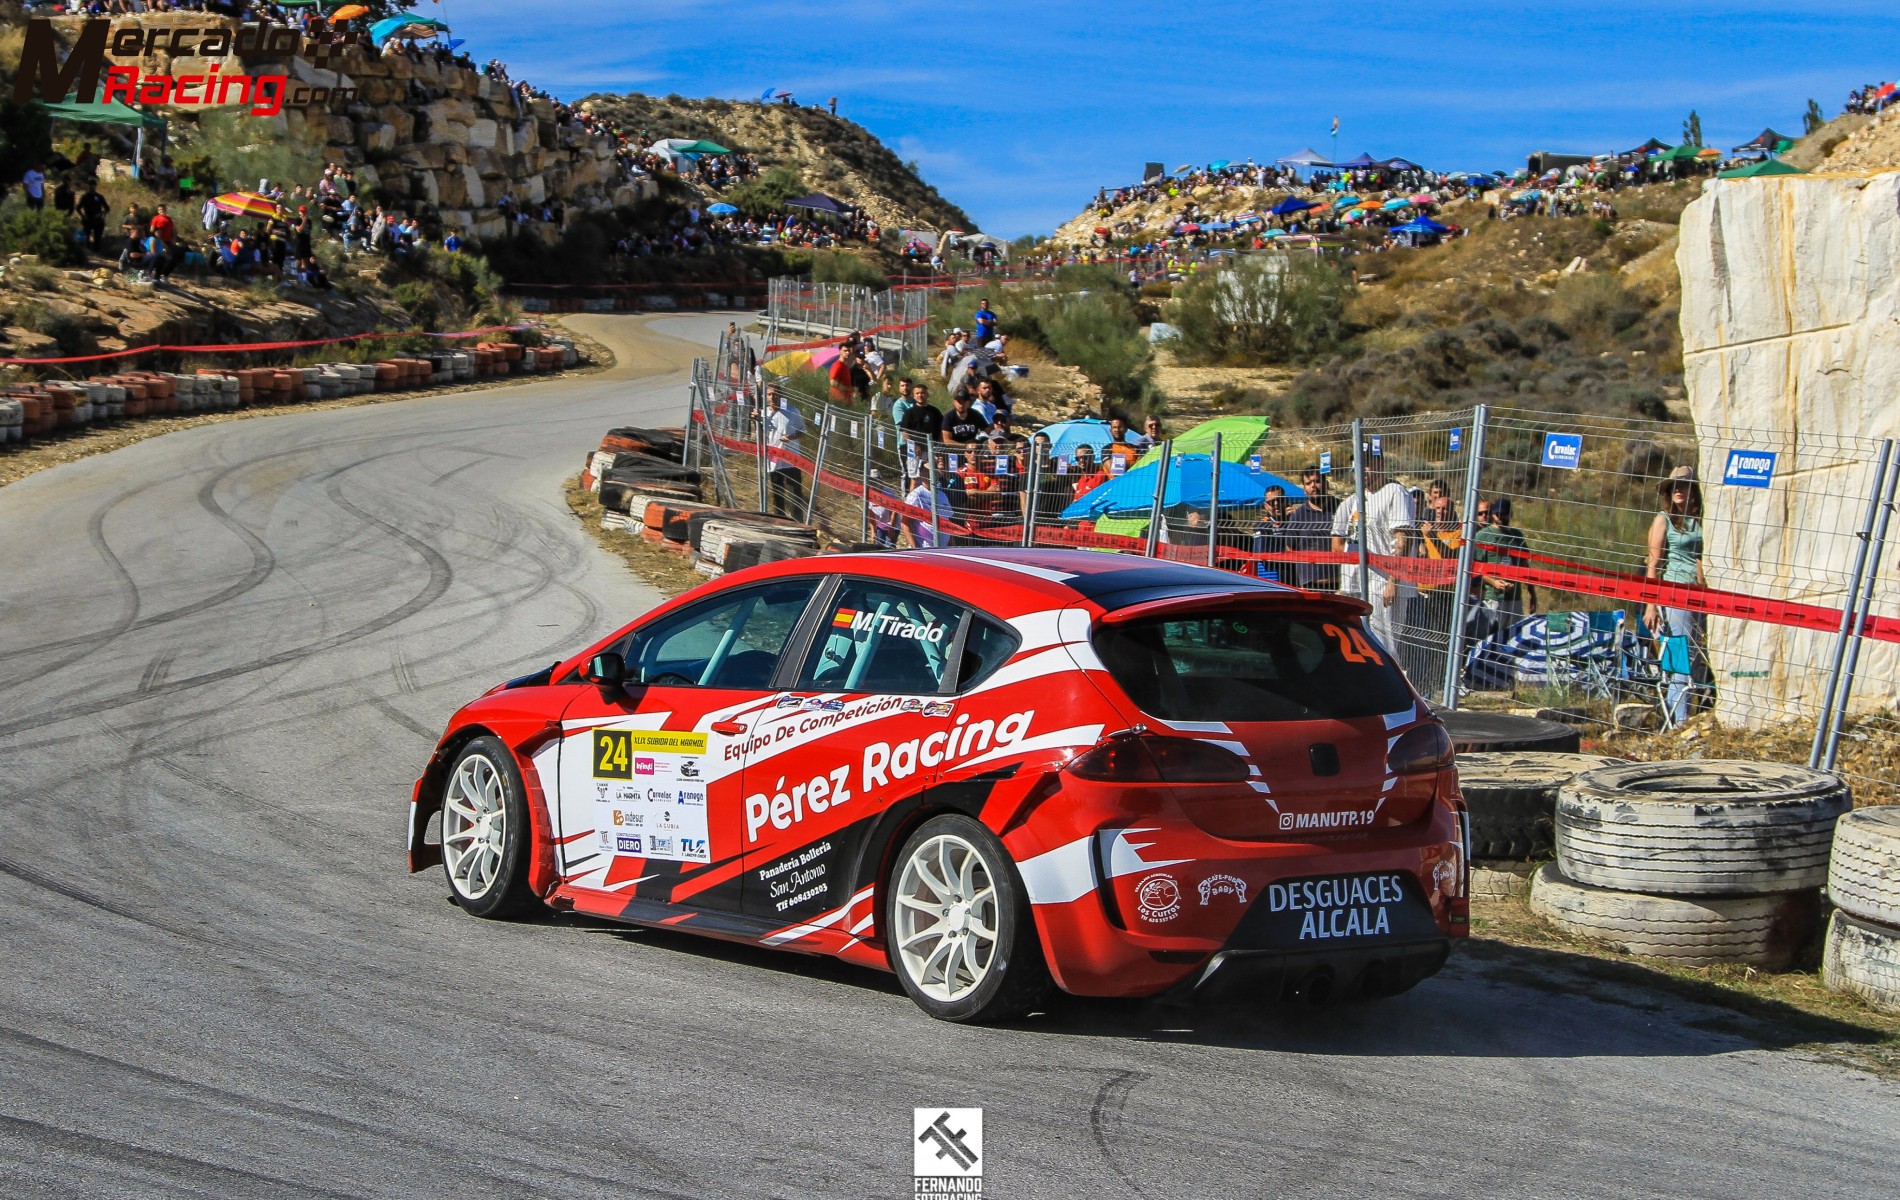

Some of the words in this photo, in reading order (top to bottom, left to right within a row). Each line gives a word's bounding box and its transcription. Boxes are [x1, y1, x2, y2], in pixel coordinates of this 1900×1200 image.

[953, 424, 976, 434] TOKYO
[1725, 454, 1771, 478] Aranega
[850, 610, 873, 632] M.
[878, 614, 943, 643] Tirado
[1322, 623, 1384, 667] 24
[646, 737, 669, 746] SUBIDA
[668, 738, 679, 747] DEL
[724, 734, 771, 761] Equipo
[775, 725, 796, 742] De
[799, 695, 903, 733] Competición
[599, 735, 628, 772] 24
[745, 764, 851, 843] Pérez
[862, 709, 1035, 793] Racing
[678, 790, 704, 805] Aranega
[1295, 810, 1375, 828] MANUTP.19
[619, 840, 640, 851] DIERO
[770, 881, 789, 898] San
[789, 864, 826, 893] Antonio
[1268, 875, 1404, 912] DESGUACES
[1137, 905, 1150, 916] Los
[1151, 904, 1181, 917] Curros
[1299, 906, 1390, 940] ALCALA
